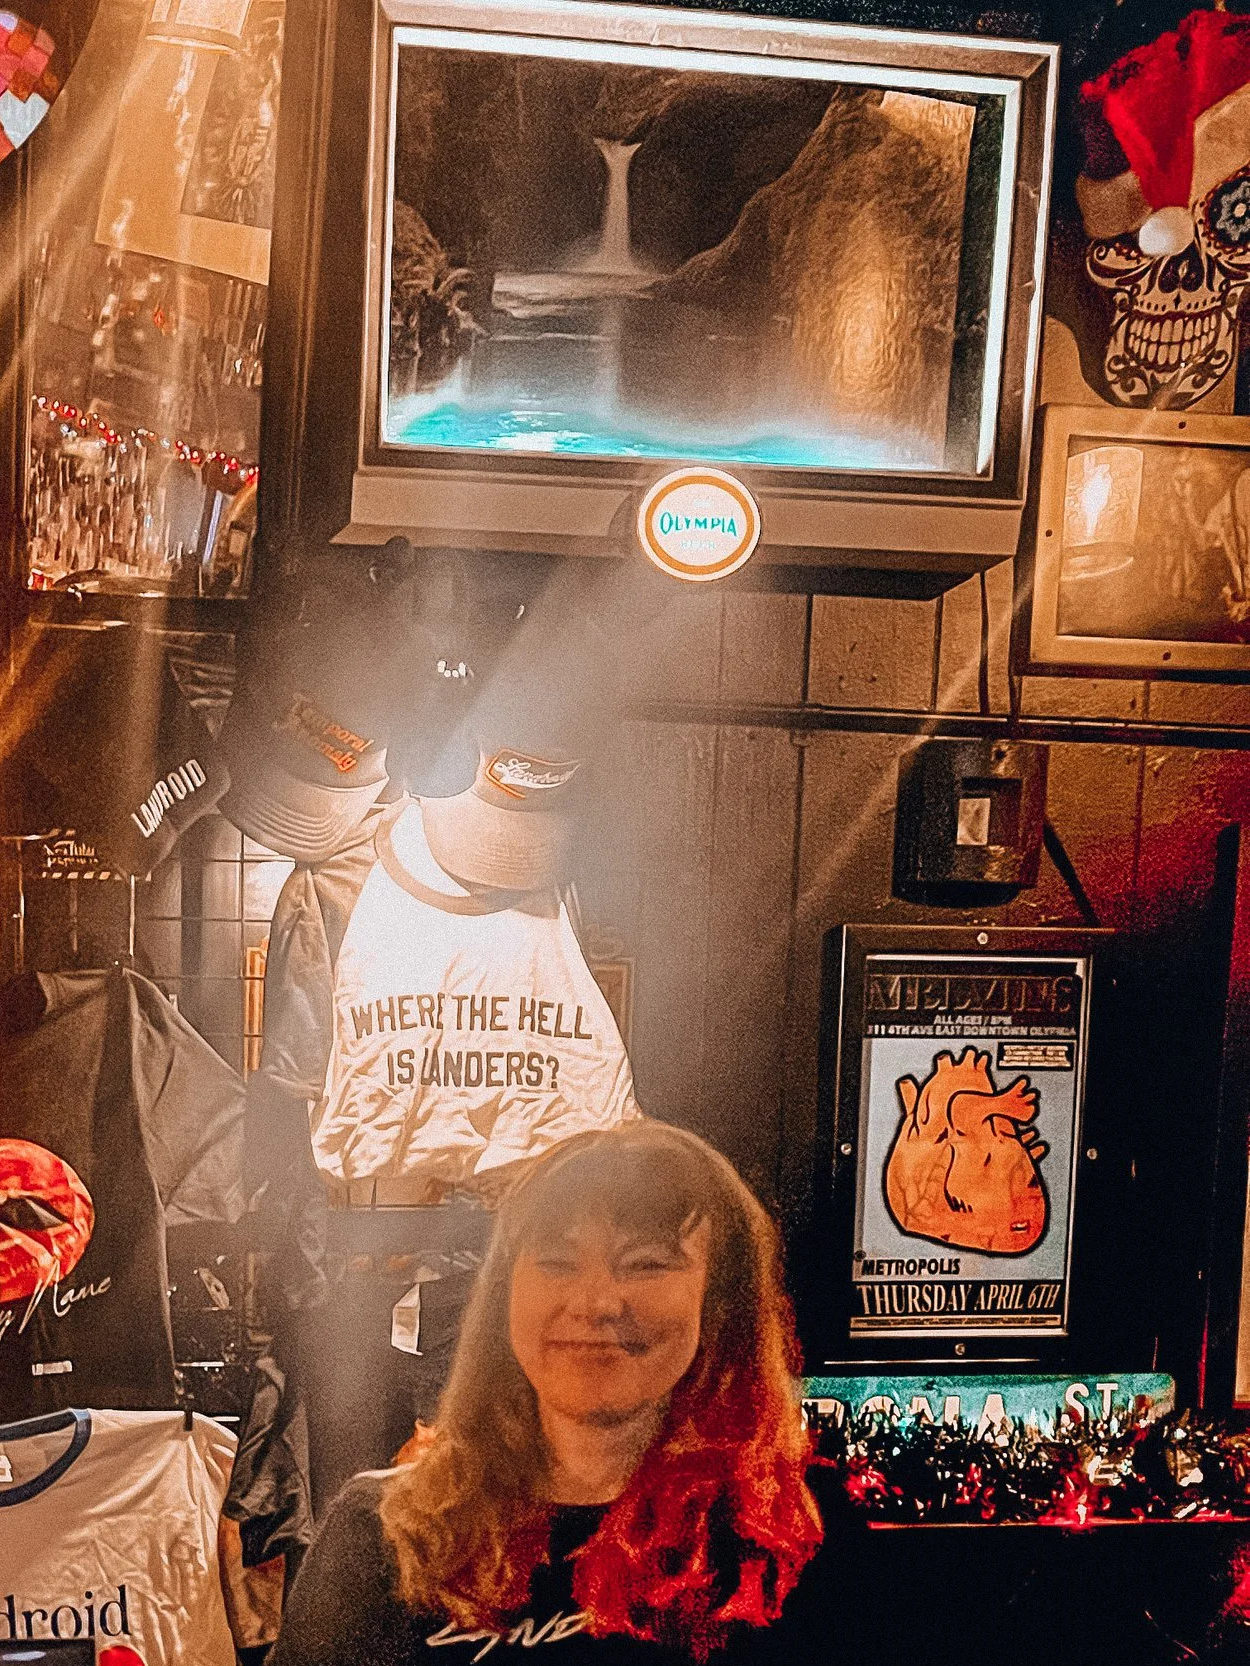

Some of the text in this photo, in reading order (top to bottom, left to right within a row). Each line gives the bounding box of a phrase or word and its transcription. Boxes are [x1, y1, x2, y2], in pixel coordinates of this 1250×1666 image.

[660, 511, 738, 537] OLYMPIA
[350, 992, 592, 1040] WHERE THE HELL
[933, 1015, 953, 1025] ALL
[936, 1026, 962, 1036] EAST
[963, 1026, 1028, 1036] DOWNTOWN
[387, 1049, 414, 1086] IS
[861, 1258, 961, 1276] METROPOLIS
[18, 1259, 112, 1334] Name
[857, 1284, 1062, 1315] THURSDAY APRIL 6TH
[1065, 1383, 1119, 1422] ST
[426, 1610, 595, 1665] LAND
